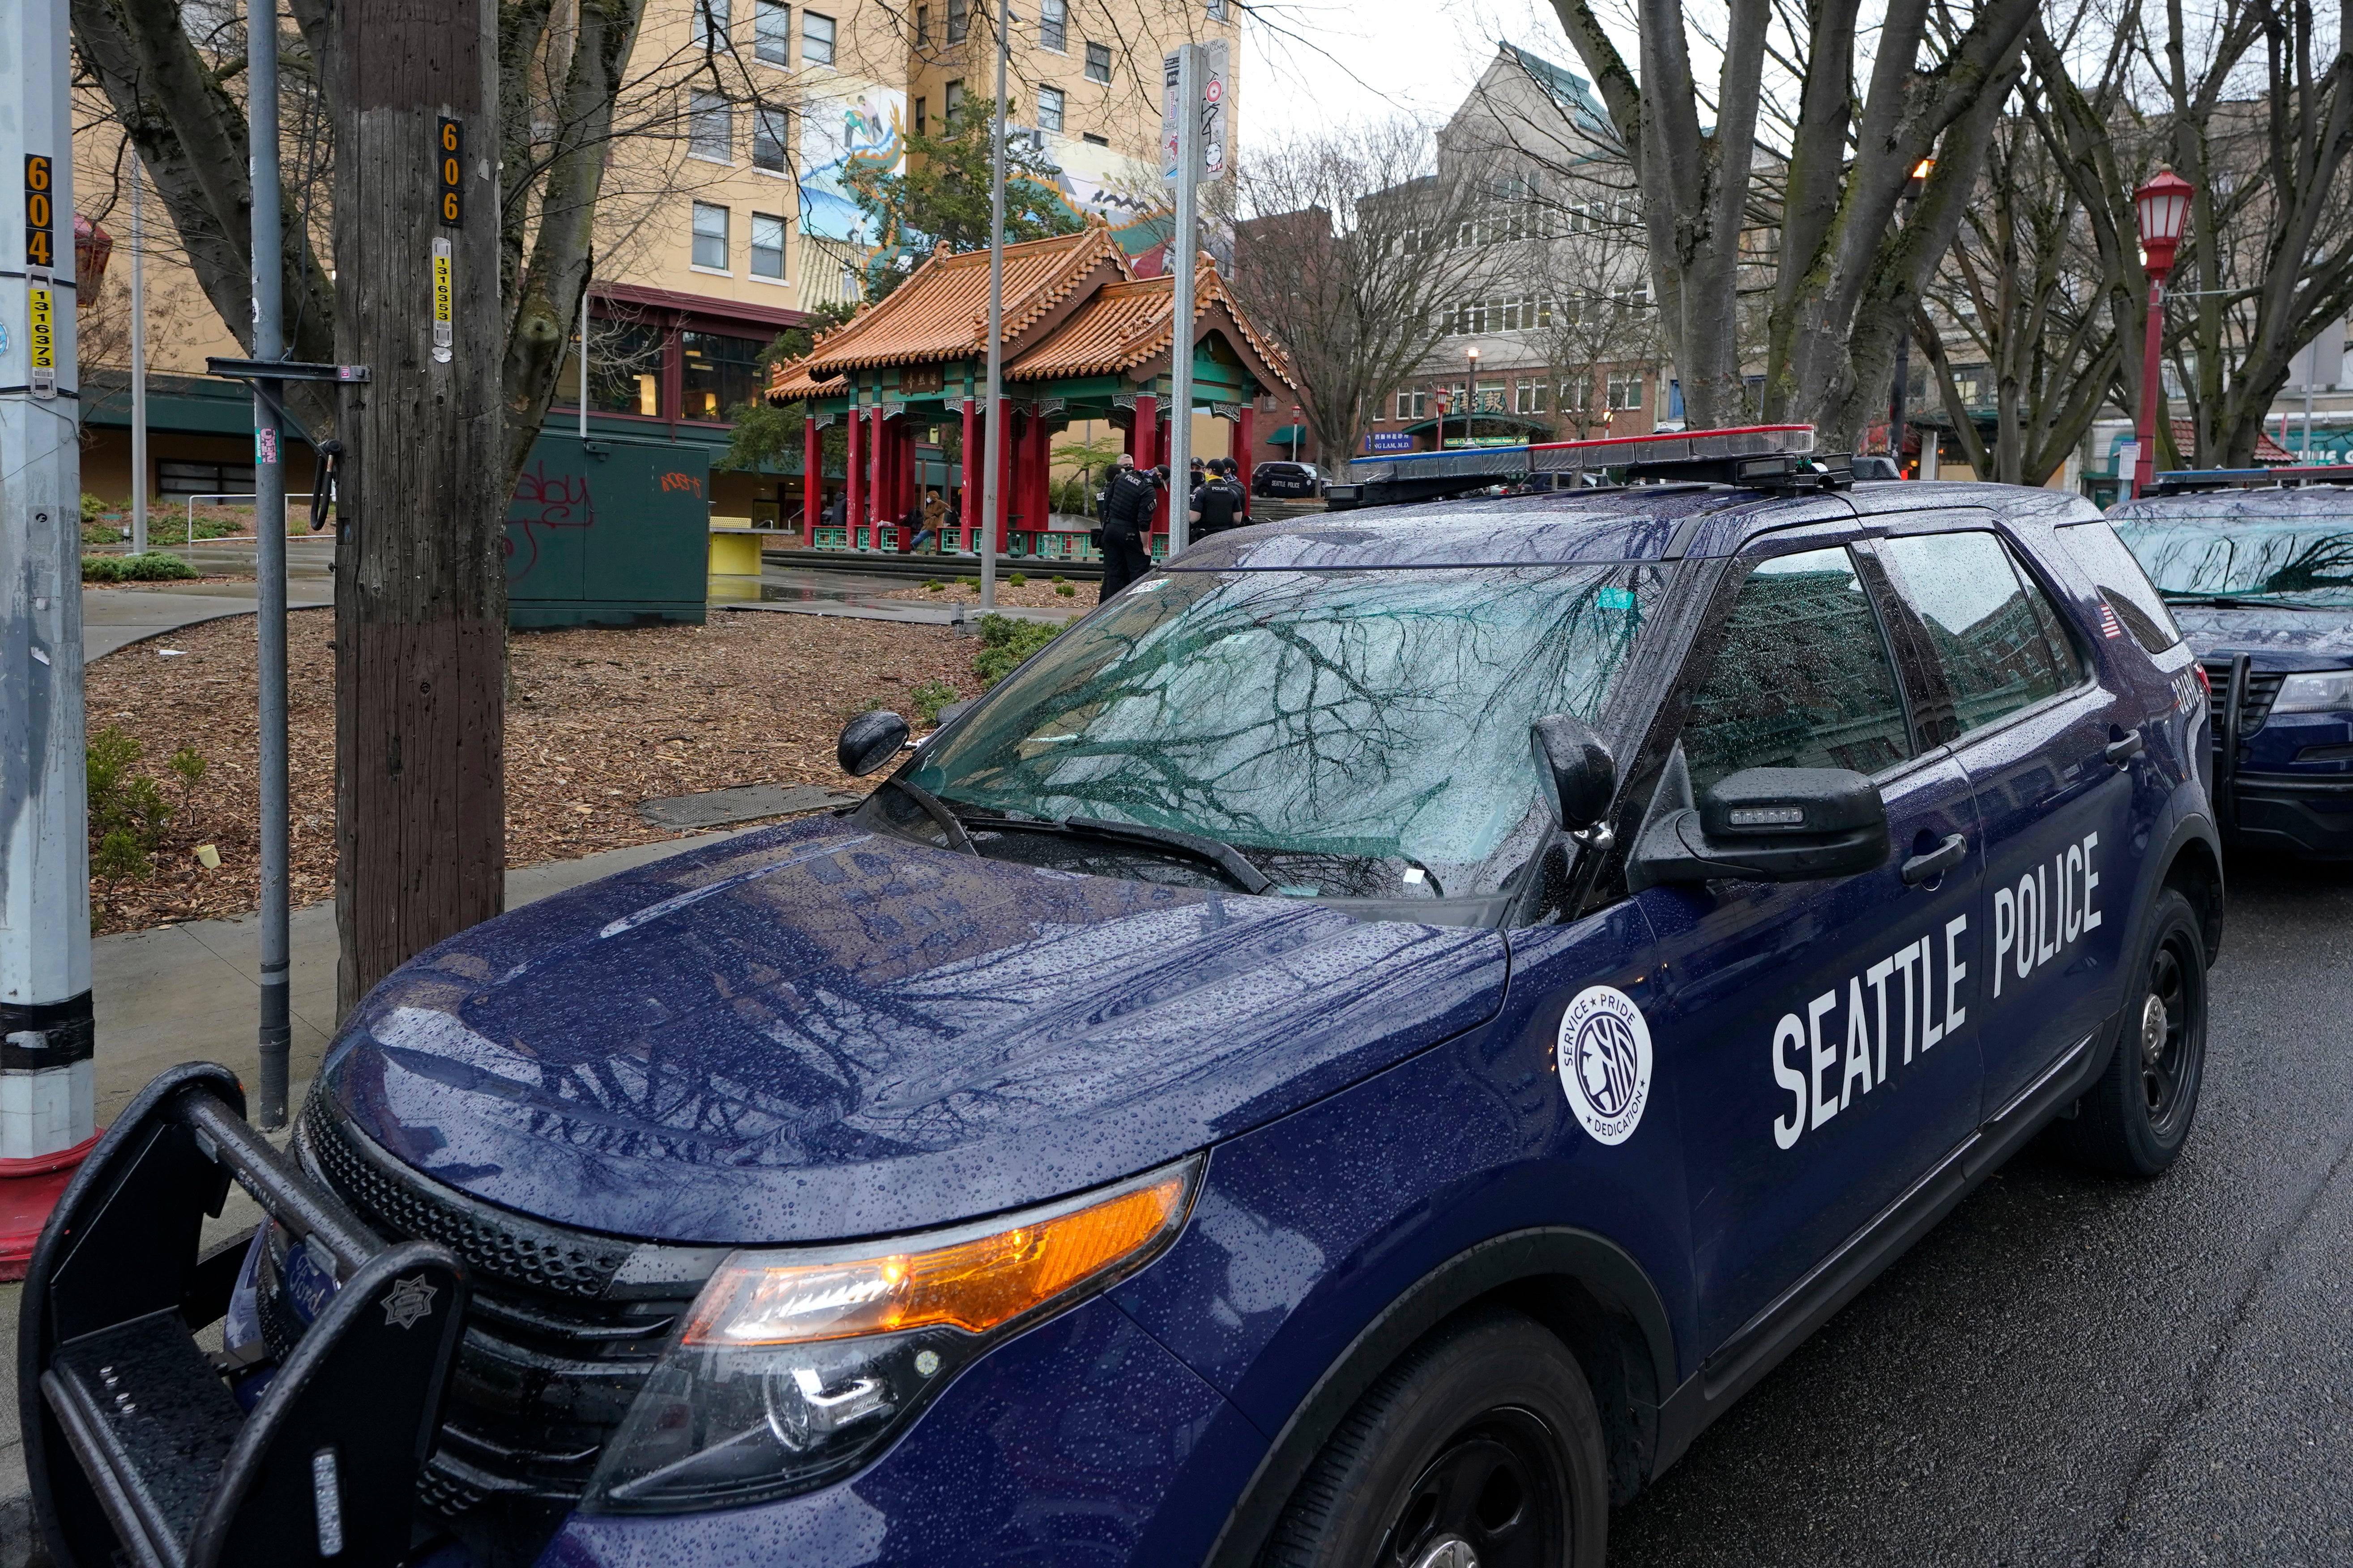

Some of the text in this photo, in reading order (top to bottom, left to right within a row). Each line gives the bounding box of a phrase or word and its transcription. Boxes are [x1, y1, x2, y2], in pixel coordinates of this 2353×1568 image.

[443, 124, 459, 220] 606
[28, 157, 50, 264] 604
[437, 258, 448, 320] 1316353
[34, 291, 51, 366] 1316373
[1124, 474, 1141, 486] POLICE
[1772, 831, 2102, 1150] SEATTLE POLICE
[1564, 993, 1636, 1066] SERVICE PRIDE
[1594, 1090, 1643, 1137] DEDICATION
